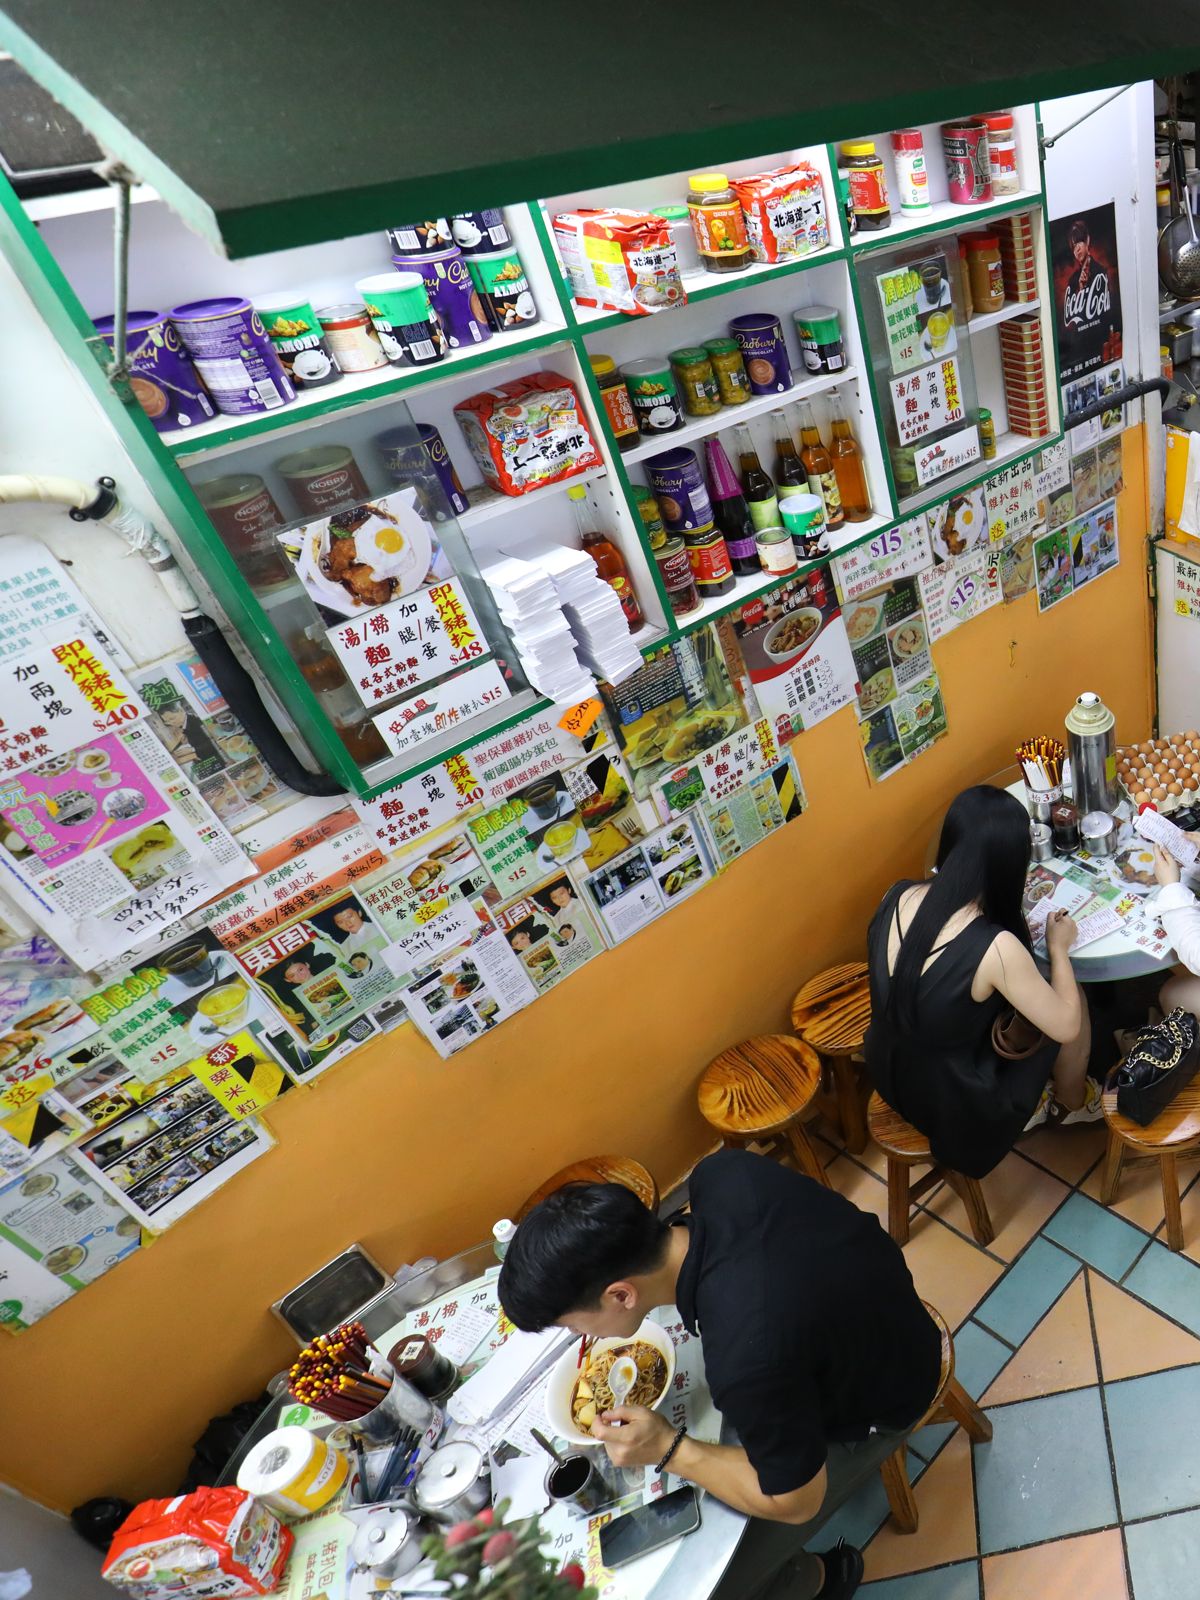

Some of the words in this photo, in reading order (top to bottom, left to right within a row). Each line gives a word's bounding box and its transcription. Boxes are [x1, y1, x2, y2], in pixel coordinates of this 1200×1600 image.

[773, 200, 823, 229] 北海道一丁
[633, 254, 678, 269] 北海道一丁
[1063, 272, 1111, 327] Coca-Cola
[900, 346, 913, 360] $15
[927, 371, 940, 409] 加兩塊
[941, 360, 959, 410] 即炸豬扒
[905, 397, 918, 415] 麵
[945, 408, 961, 423] $40
[311, 475, 345, 489] NOBRE
[870, 527, 902, 558] $15
[950, 576, 975, 610] $15
[399, 603, 418, 618] 加
[427, 583, 477, 648] 即炸豬扒
[742, 602, 762, 618] Coca-Cola
[337, 613, 390, 650] 湯/撈
[364, 643, 393, 669] 麵
[449, 641, 484, 666] $48
[51, 638, 129, 714] 即炸豬扒
[359, 656, 420, 690] 或各式粉麵
[372, 672, 421, 700] 奉送熱飲
[13, 663, 73, 720] 加兩塊
[92, 703, 140, 733] $40
[388, 698, 430, 735] 好消息
[474, 721, 552, 768] 聖保羅豬扒包
[738, 733, 748, 745] 加
[754, 718, 777, 761] 即炸豬扒
[482, 737, 558, 783] 葡國腸炒蛋包
[714, 762, 729, 779] 麵
[760, 755, 779, 773] $48
[421, 774, 445, 802] 兩塊
[455, 787, 484, 811] $40
[375, 806, 430, 840] 或各式粉麵
[379, 798, 406, 820] 麵
[467, 797, 529, 845] 潤喉必飲
[388, 820, 431, 847] 奉送熱飲
[482, 825, 530, 861] 羅漢果蜜
[490, 839, 538, 875] 無花果蜜
[508, 866, 527, 882] $15
[212, 905, 260, 936] 菠蘿冰
[272, 871, 319, 902] 雜果冰
[377, 886, 418, 915] 辣魚包
[81, 967, 168, 1024] 潤喉必飲
[109, 997, 174, 1043] 羅漢果蜜
[121, 1011, 188, 1058] 無花果蜜
[150, 1044, 178, 1065] $15
[210, 1042, 237, 1065] 新
[471, 1292, 488, 1305] 加
[414, 1300, 459, 1329] 湯/撈
[555, 1533, 573, 1549] 加
